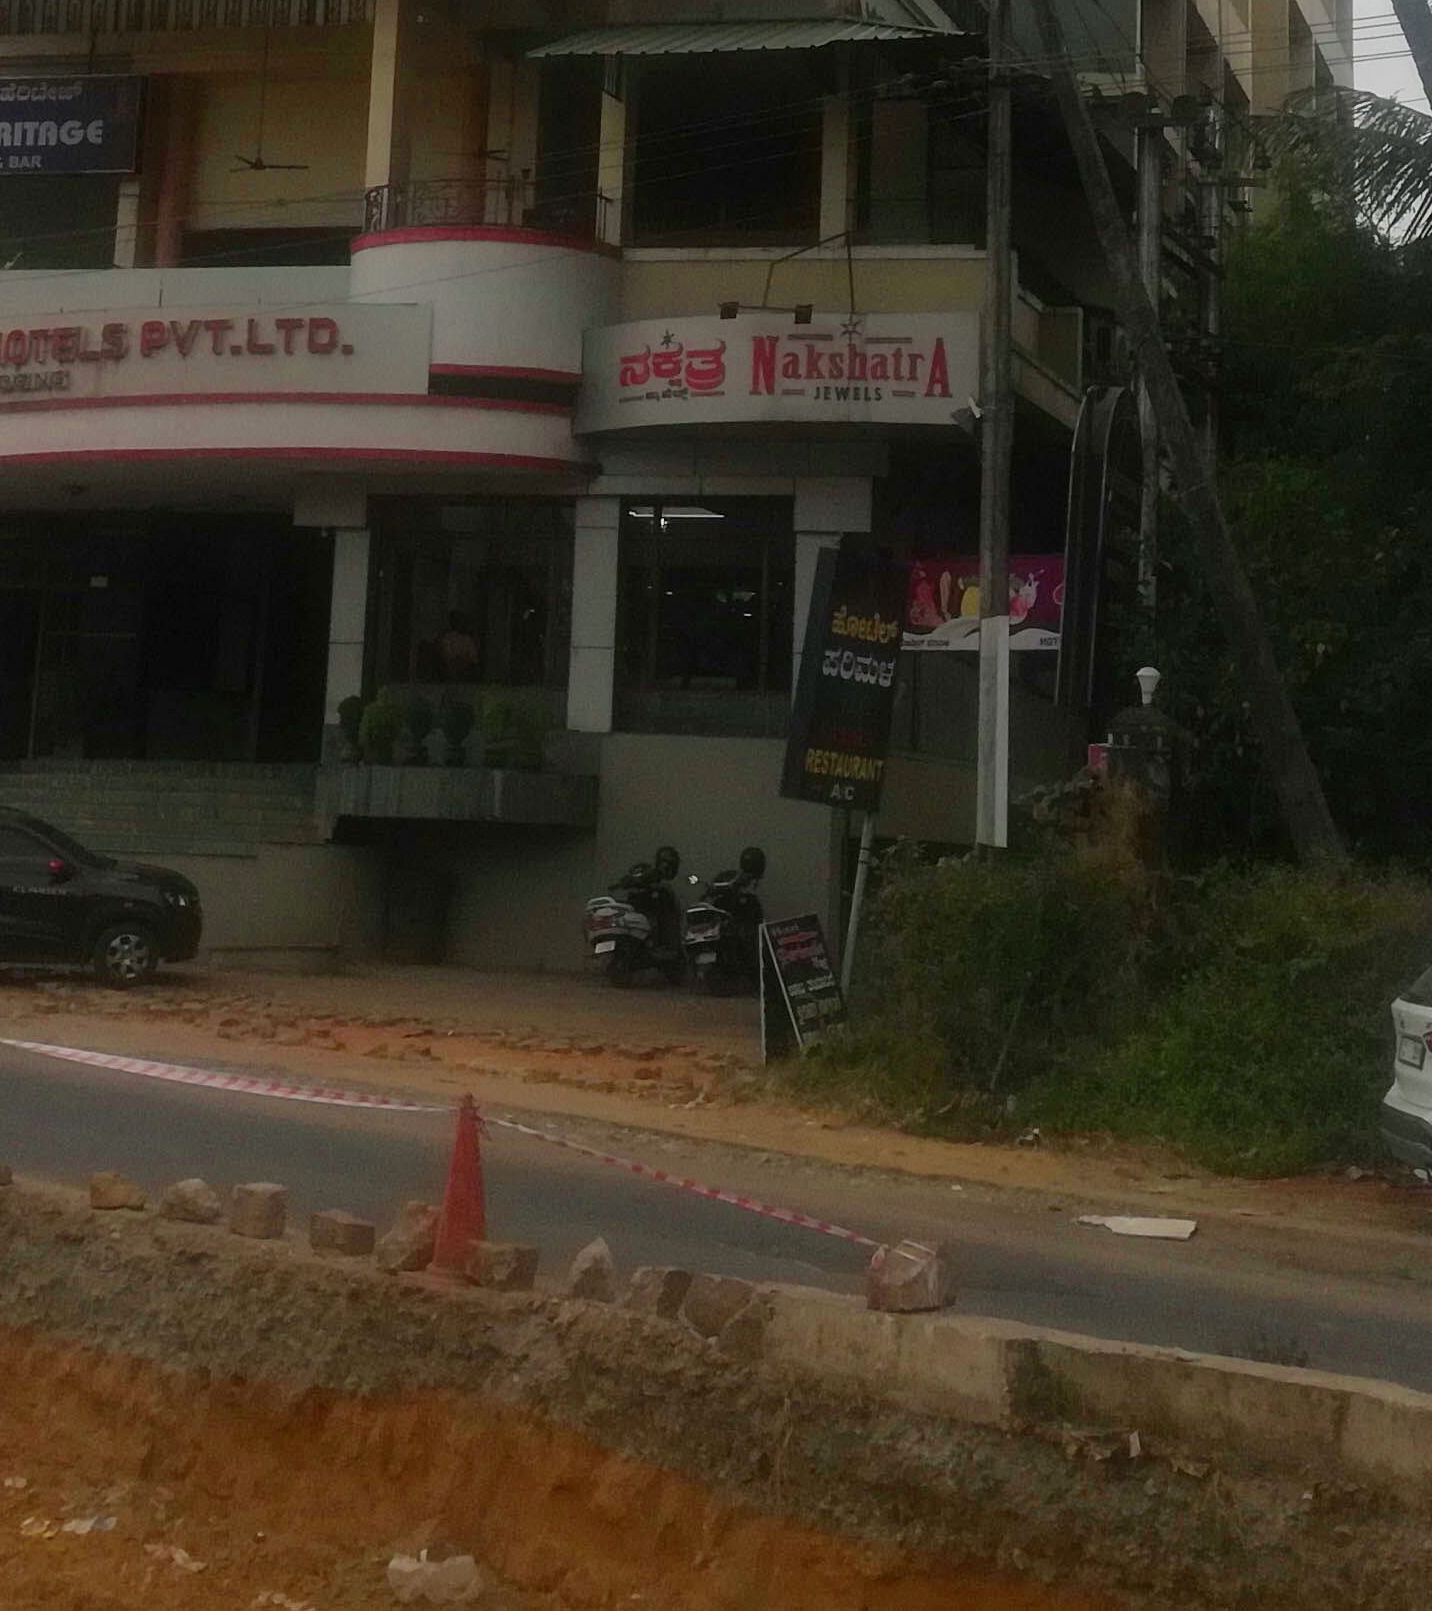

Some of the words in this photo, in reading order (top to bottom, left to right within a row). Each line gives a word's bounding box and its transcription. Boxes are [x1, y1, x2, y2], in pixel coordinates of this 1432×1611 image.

[9, 154, 42, 169] BAR
[815, 386, 884, 401] JEWELS
[804, 748, 885, 781] RESTAURANT
